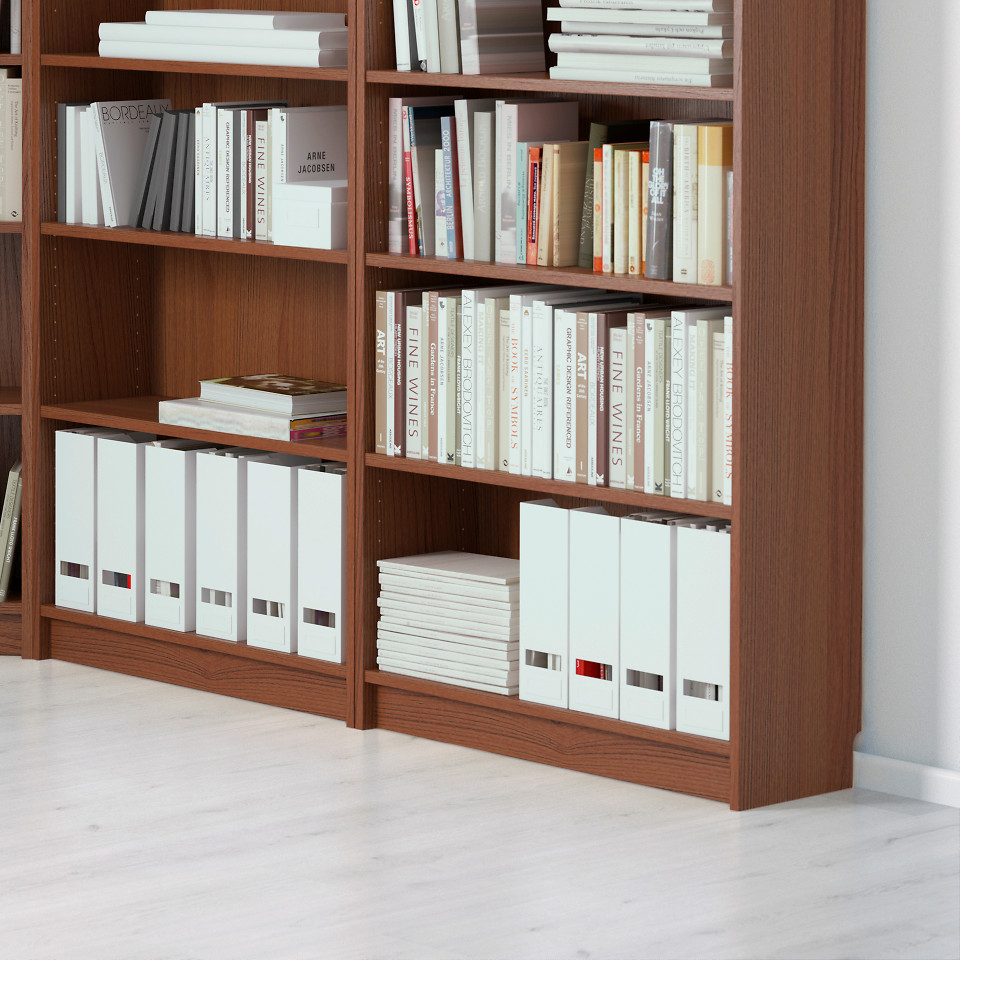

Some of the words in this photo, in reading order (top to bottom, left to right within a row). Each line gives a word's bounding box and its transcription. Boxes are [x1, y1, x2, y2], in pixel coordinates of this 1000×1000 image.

[257, 137, 265, 170] FINE
[297, 163, 335, 174] JACOBSEN
[307, 151, 326, 161] ARNE
[444, 156, 453, 198] ARCHITEKTUR
[257, 176, 265, 225] WINES
[405, 176, 415, 240] SYMBOLISMUS
[446, 205, 455, 230] BERLIN
[376, 329, 386, 356] ART
[463, 295, 472, 354] ALEXEY
[408, 327, 419, 369] FINE
[511, 337, 520, 373] BOOK
[577, 352, 587, 380] ART
[673, 316, 683, 379] ALEXEY
[430, 378, 437, 386] in
[612, 350, 623, 394] FINE
[408, 377, 419, 438] WINES
[463, 358, 472, 456] BRODOVITCH
[511, 387, 520, 449] SYMBOLS
[637, 403, 643, 412] in
[612, 403, 623, 467] WINES
[673, 384, 683, 486] BRODOVITCH
